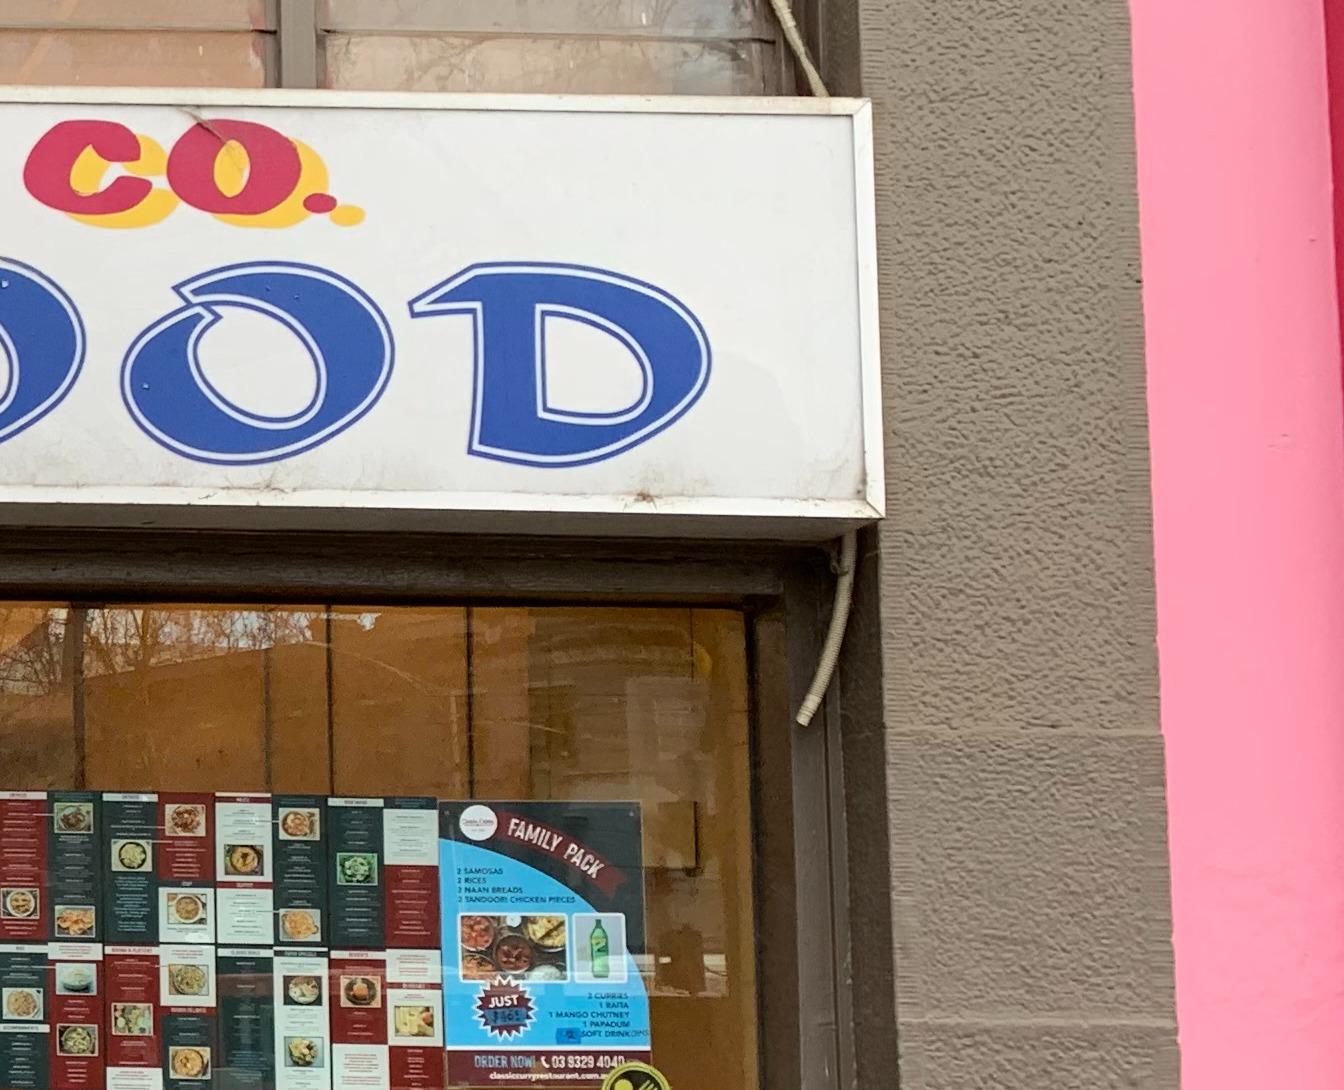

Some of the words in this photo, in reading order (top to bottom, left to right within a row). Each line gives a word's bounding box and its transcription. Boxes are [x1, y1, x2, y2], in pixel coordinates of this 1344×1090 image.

[23, 117, 365, 229] CO.
[507, 817, 563, 852] FAMILY
[564, 843, 605, 879] PACK
[488, 995, 519, 1008] JUST
[582, 1030, 602, 1038] SOFT
[605, 1030, 631, 1038] DRINK
[474, 1056, 508, 1068] ORDER
[551, 1056, 566, 1068] 03
[568, 1056, 594, 1069] 9329
[596, 1056, 625, 1068] 4040
